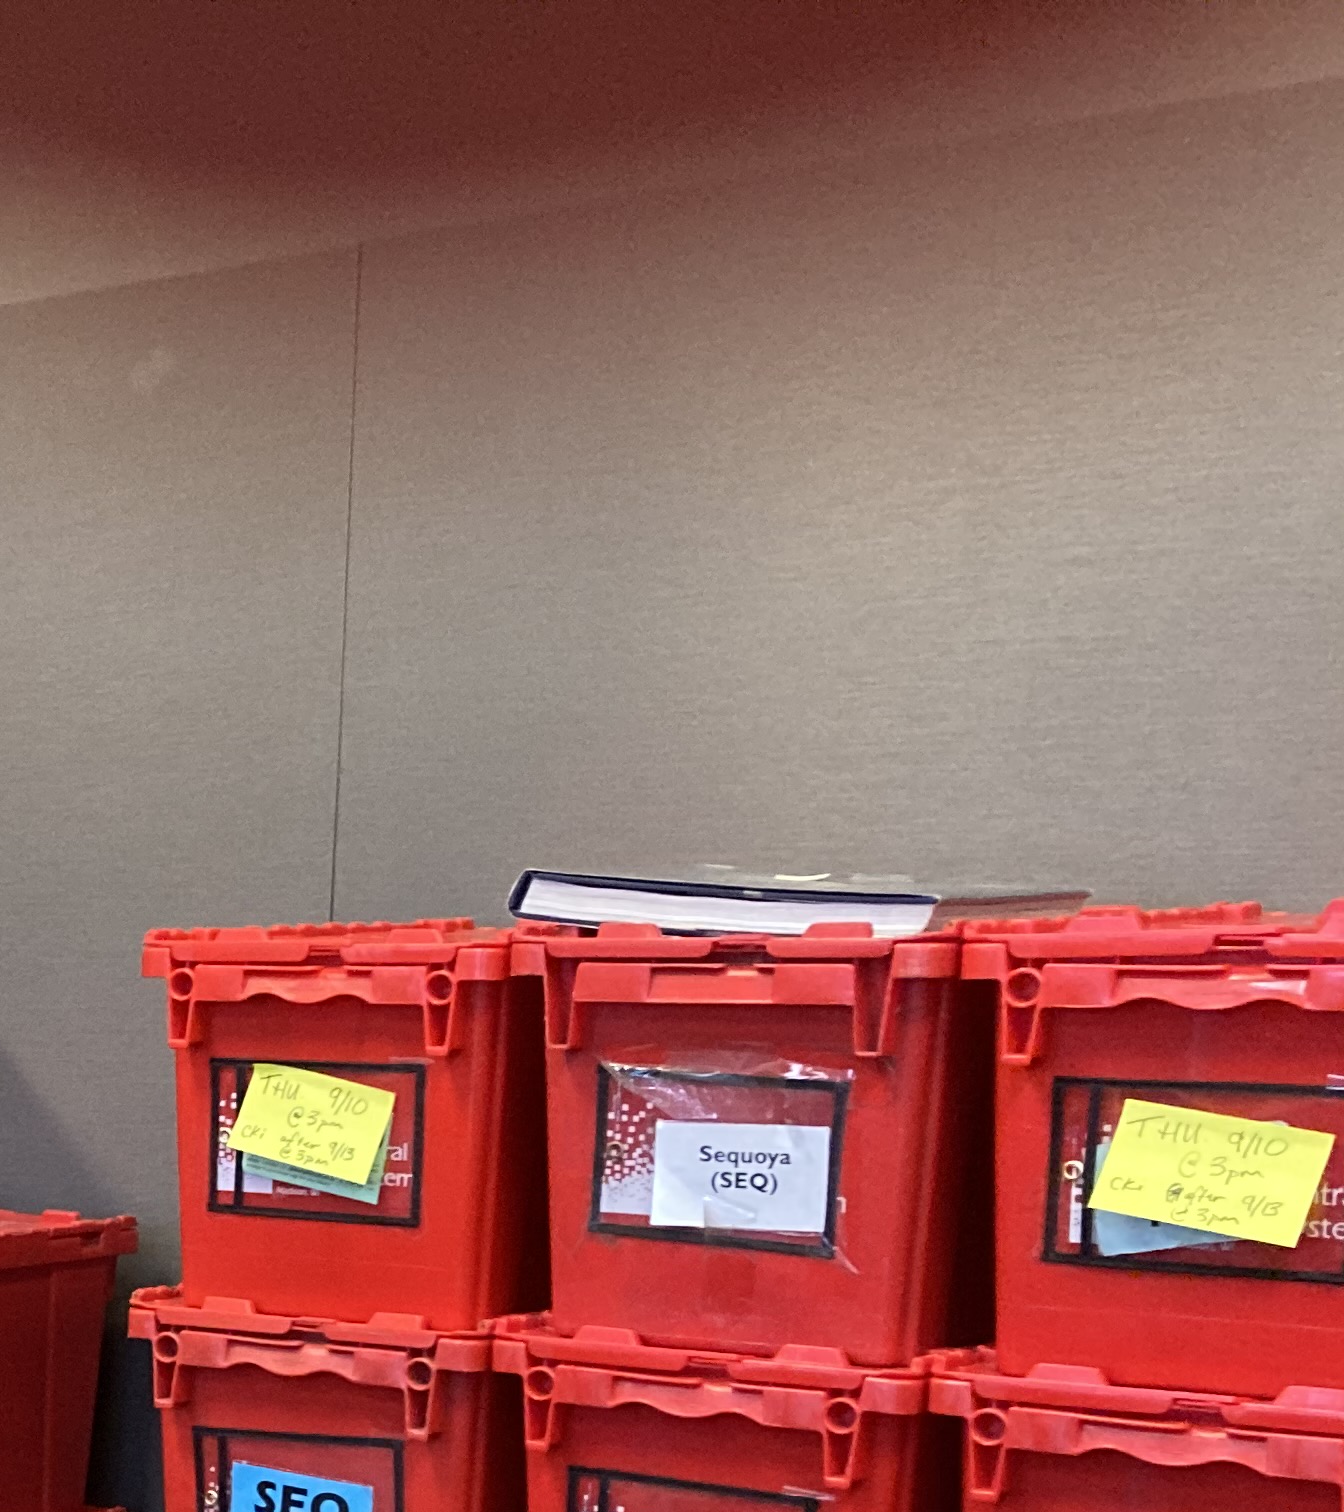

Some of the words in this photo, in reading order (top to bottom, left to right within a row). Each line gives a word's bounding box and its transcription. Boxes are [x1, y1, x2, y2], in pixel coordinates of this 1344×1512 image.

[328, 1086, 368, 1116] 9/10
[699, 1145, 792, 1169] Sequoya
[1227, 1129, 1289, 1159] 9/10
[711, 1171, 778, 1195] (SEQ)
